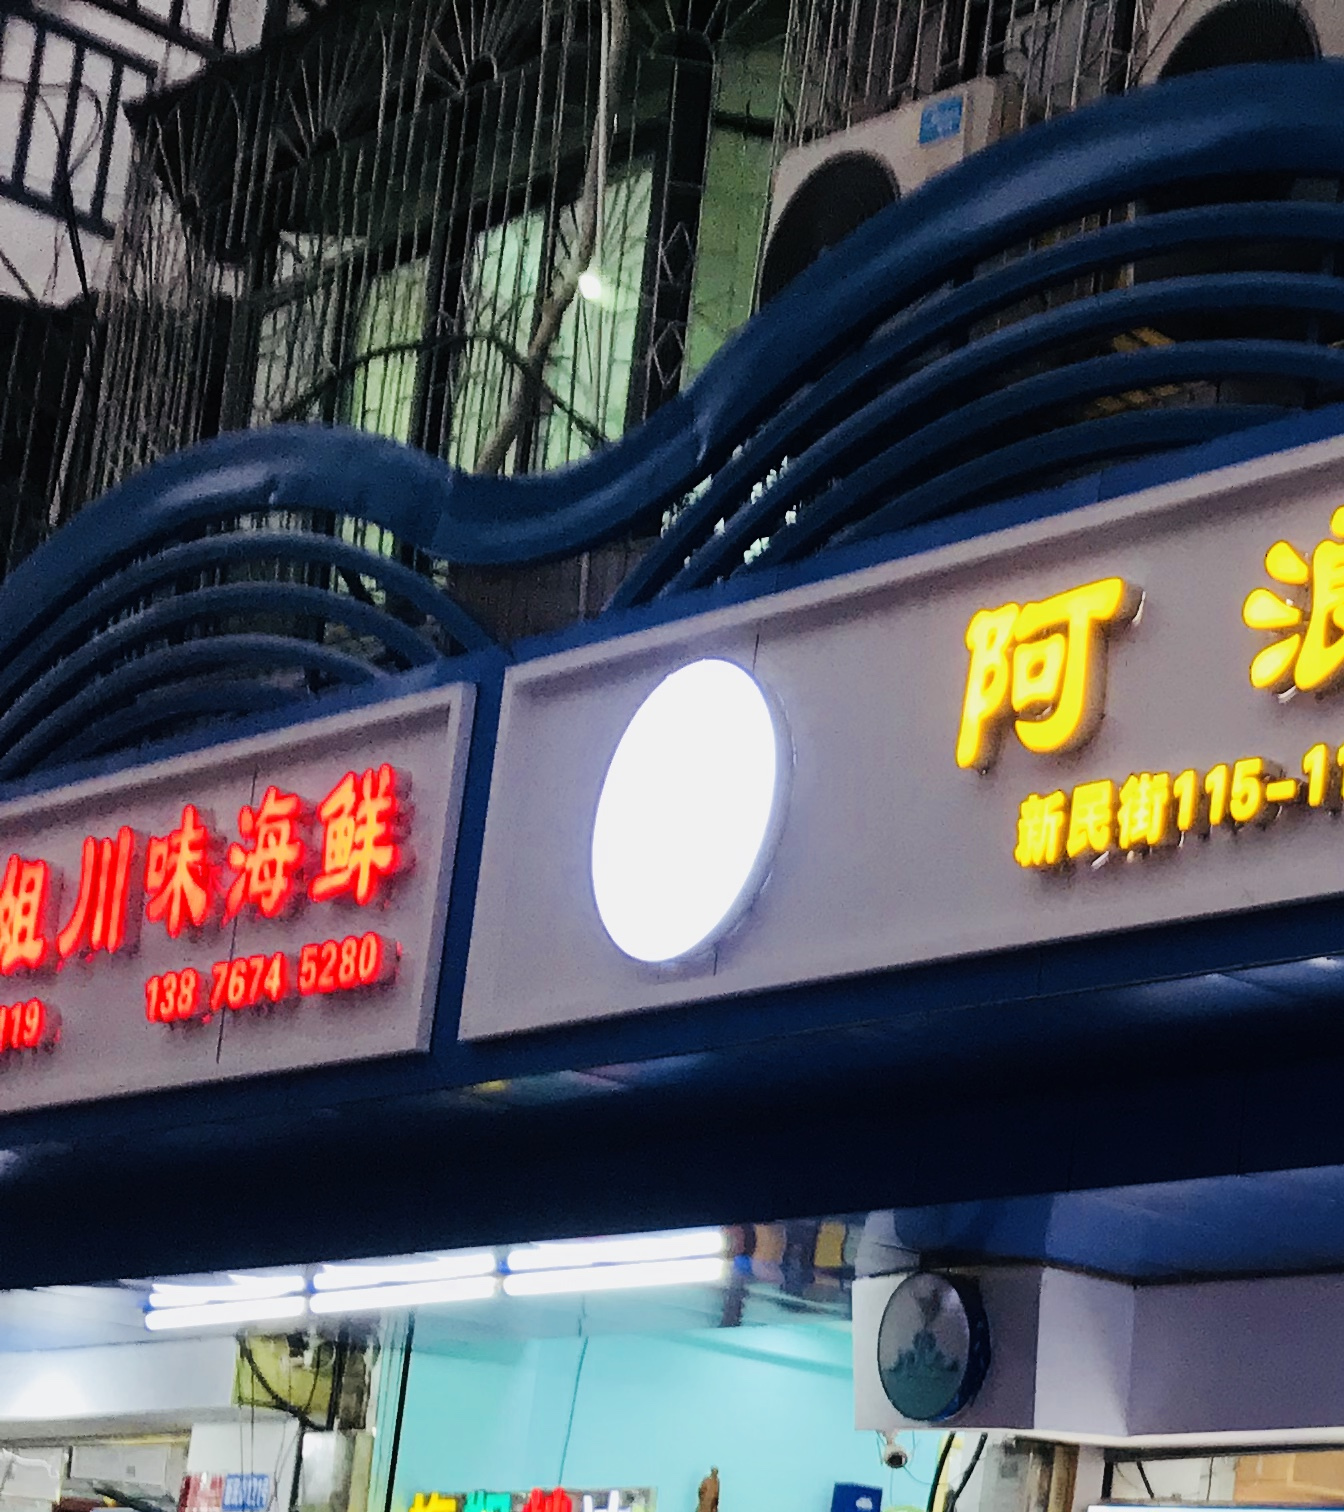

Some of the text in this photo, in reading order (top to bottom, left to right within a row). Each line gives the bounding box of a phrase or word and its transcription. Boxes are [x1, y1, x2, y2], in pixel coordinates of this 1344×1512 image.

[145, 932, 384, 1024] 138 7674 5280
